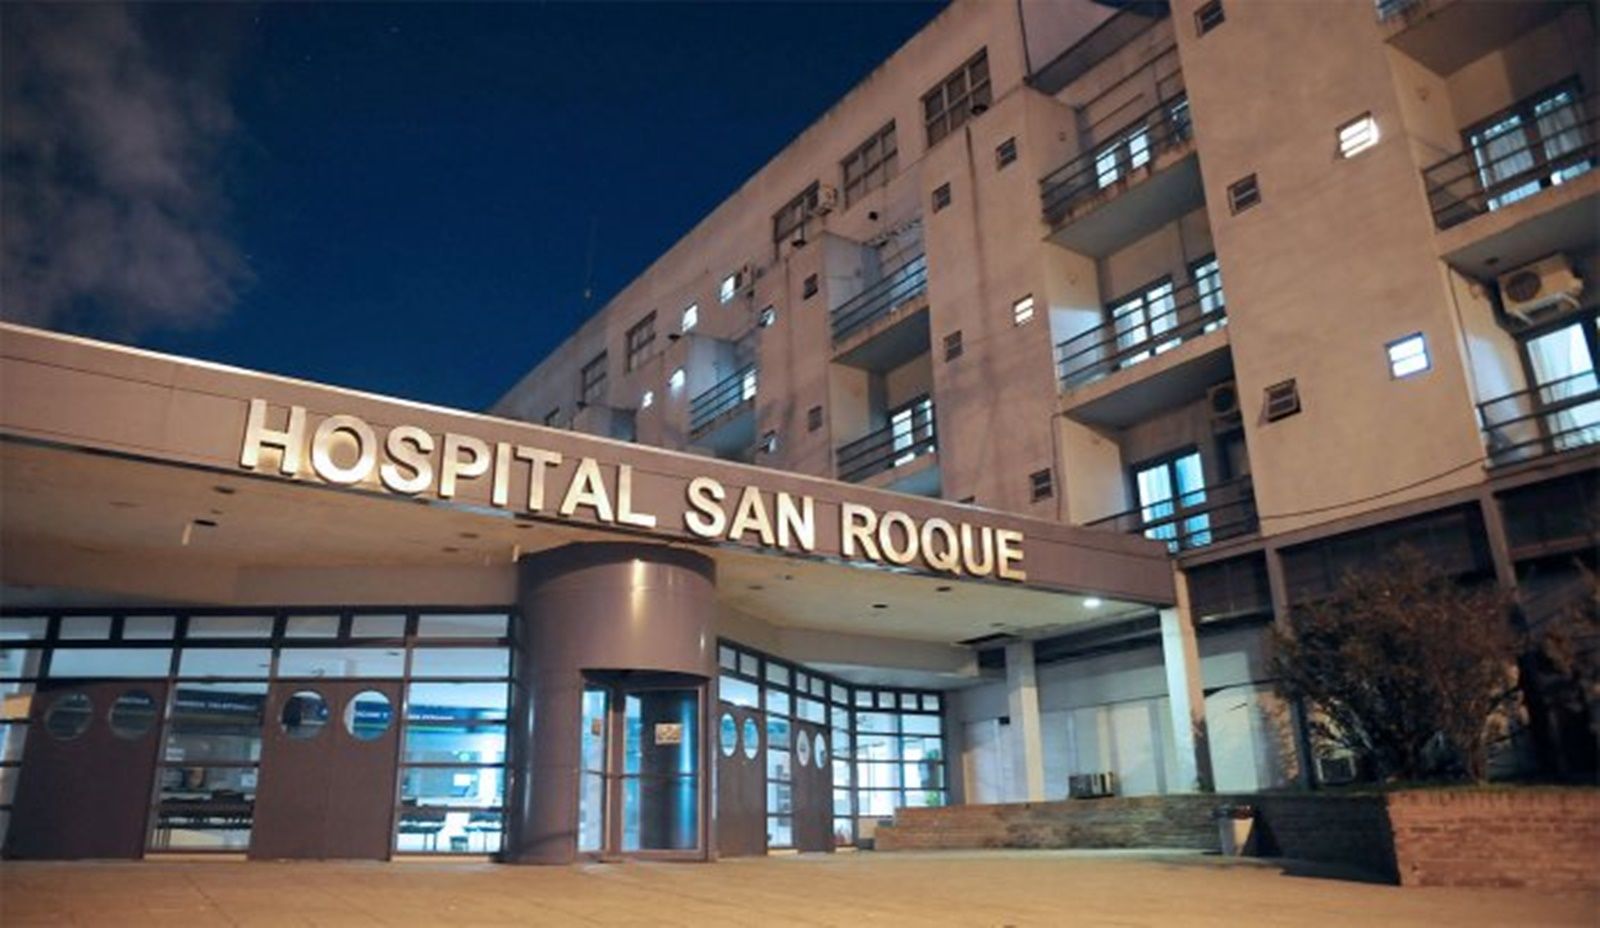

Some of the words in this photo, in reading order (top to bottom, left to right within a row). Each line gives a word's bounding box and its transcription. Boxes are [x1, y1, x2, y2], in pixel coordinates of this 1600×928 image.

[239, 399, 656, 528] HOSPITAL
[684, 476, 815, 551] SAN
[841, 501, 1026, 581] ROQUE
